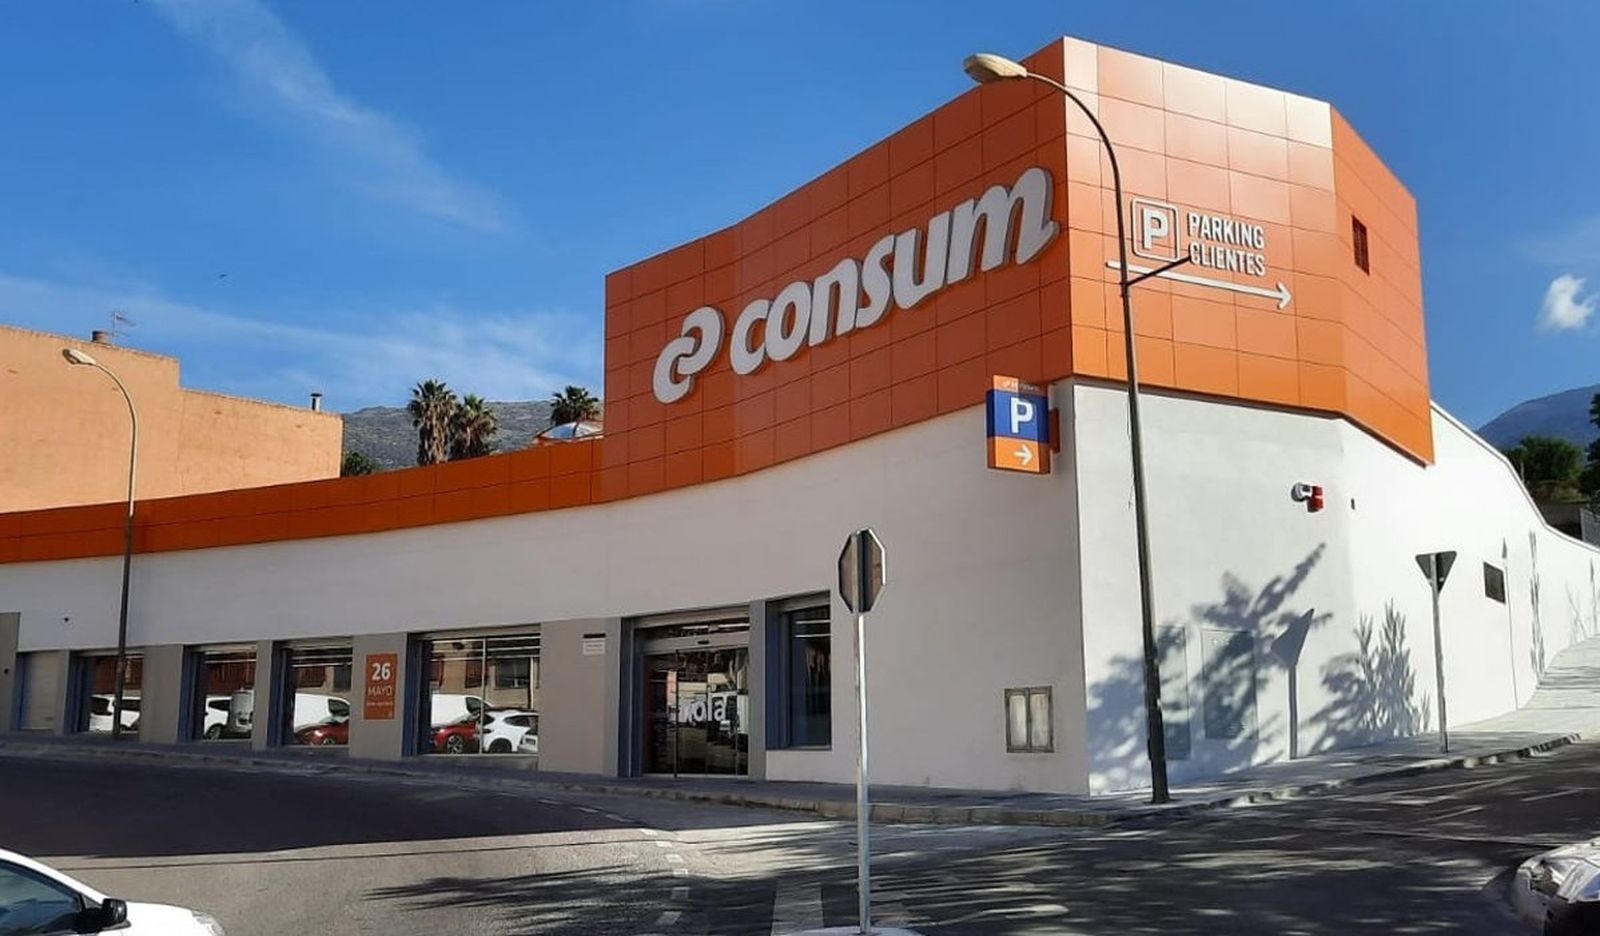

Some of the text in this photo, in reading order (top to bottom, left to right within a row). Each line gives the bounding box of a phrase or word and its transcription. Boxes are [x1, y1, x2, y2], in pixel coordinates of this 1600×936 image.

[1142, 208, 1168, 249] P
[1187, 212, 1265, 249] PARKING
[730, 167, 1059, 375] consum
[1188, 242, 1265, 276] CLIENTES
[1010, 396, 1034, 434] P
[371, 662, 391, 681] 26
[367, 684, 393, 697] MAYO
